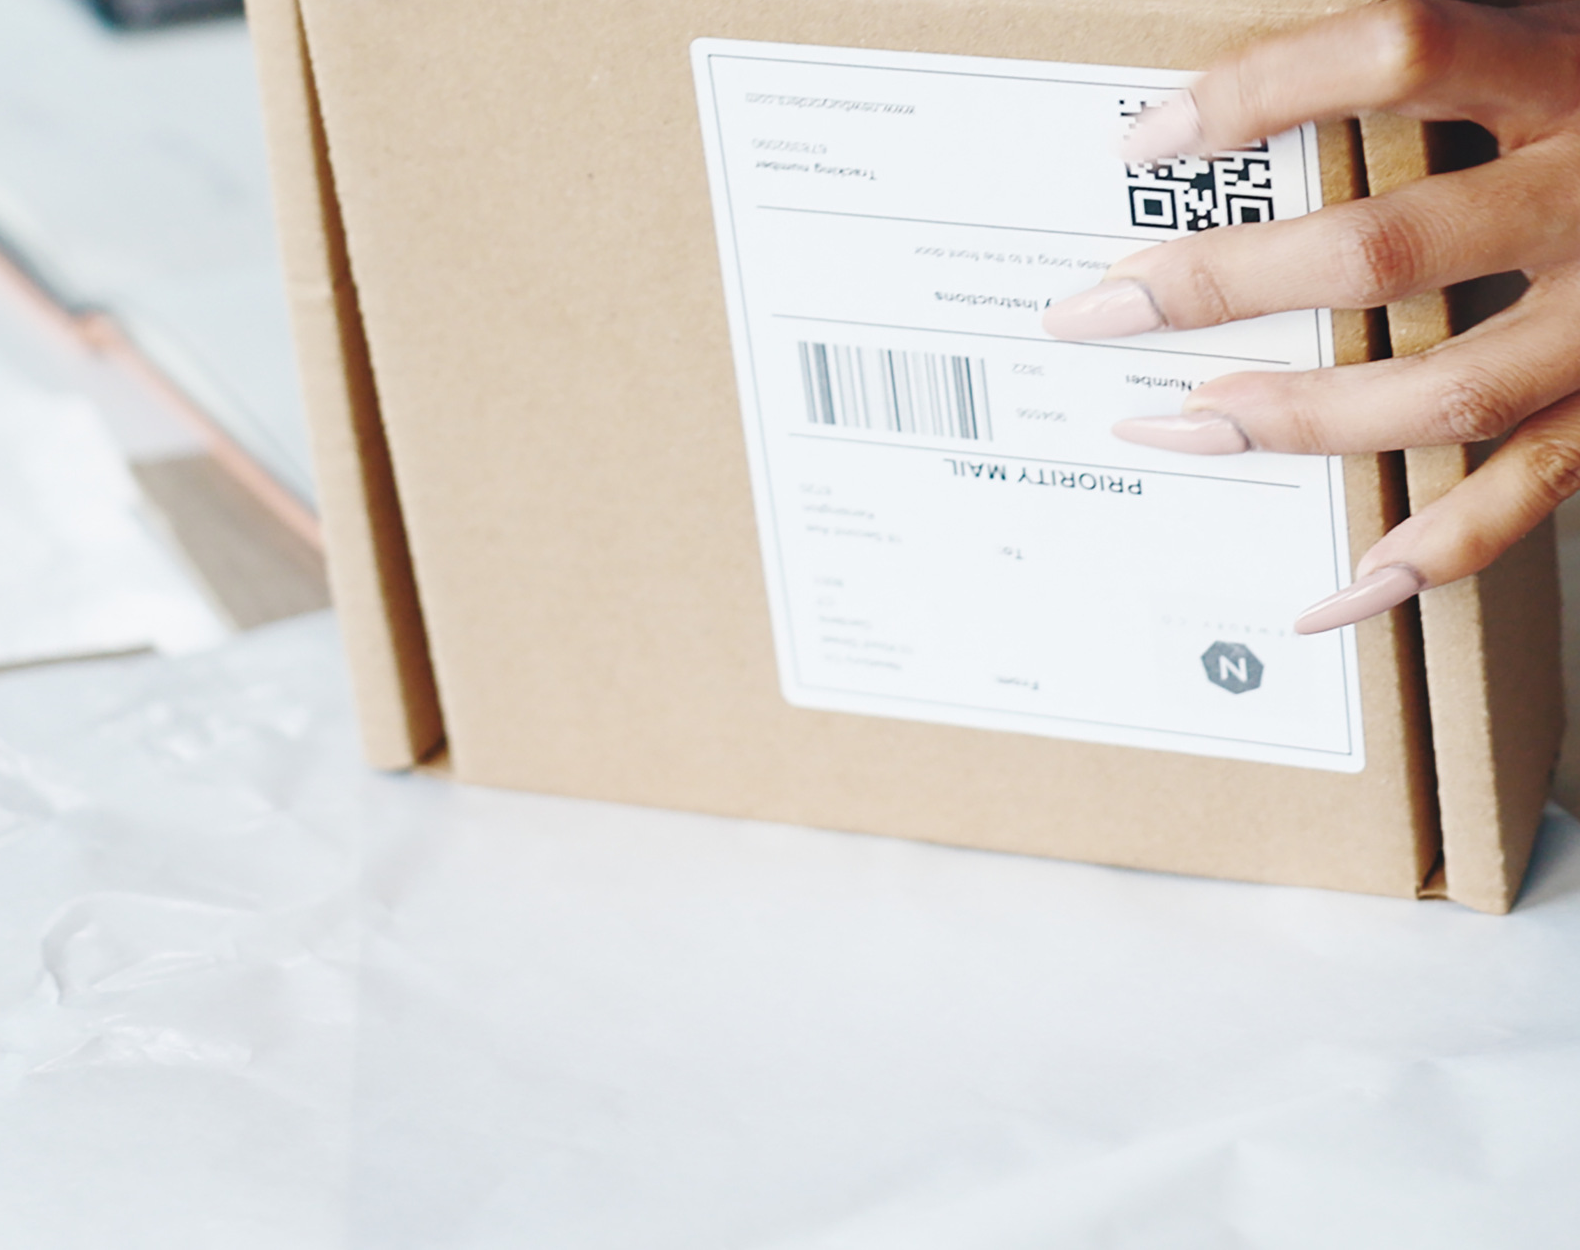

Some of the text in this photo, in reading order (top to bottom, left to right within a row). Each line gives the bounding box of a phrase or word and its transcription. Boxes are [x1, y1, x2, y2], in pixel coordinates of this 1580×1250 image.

[755, 160, 877, 182] Tracking number
[934, 291, 1039, 312] Instructions
[1124, 374, 1193, 393] Number
[942, 458, 1143, 496] PRIORITY MAIL
[1219, 655, 1249, 684] N
